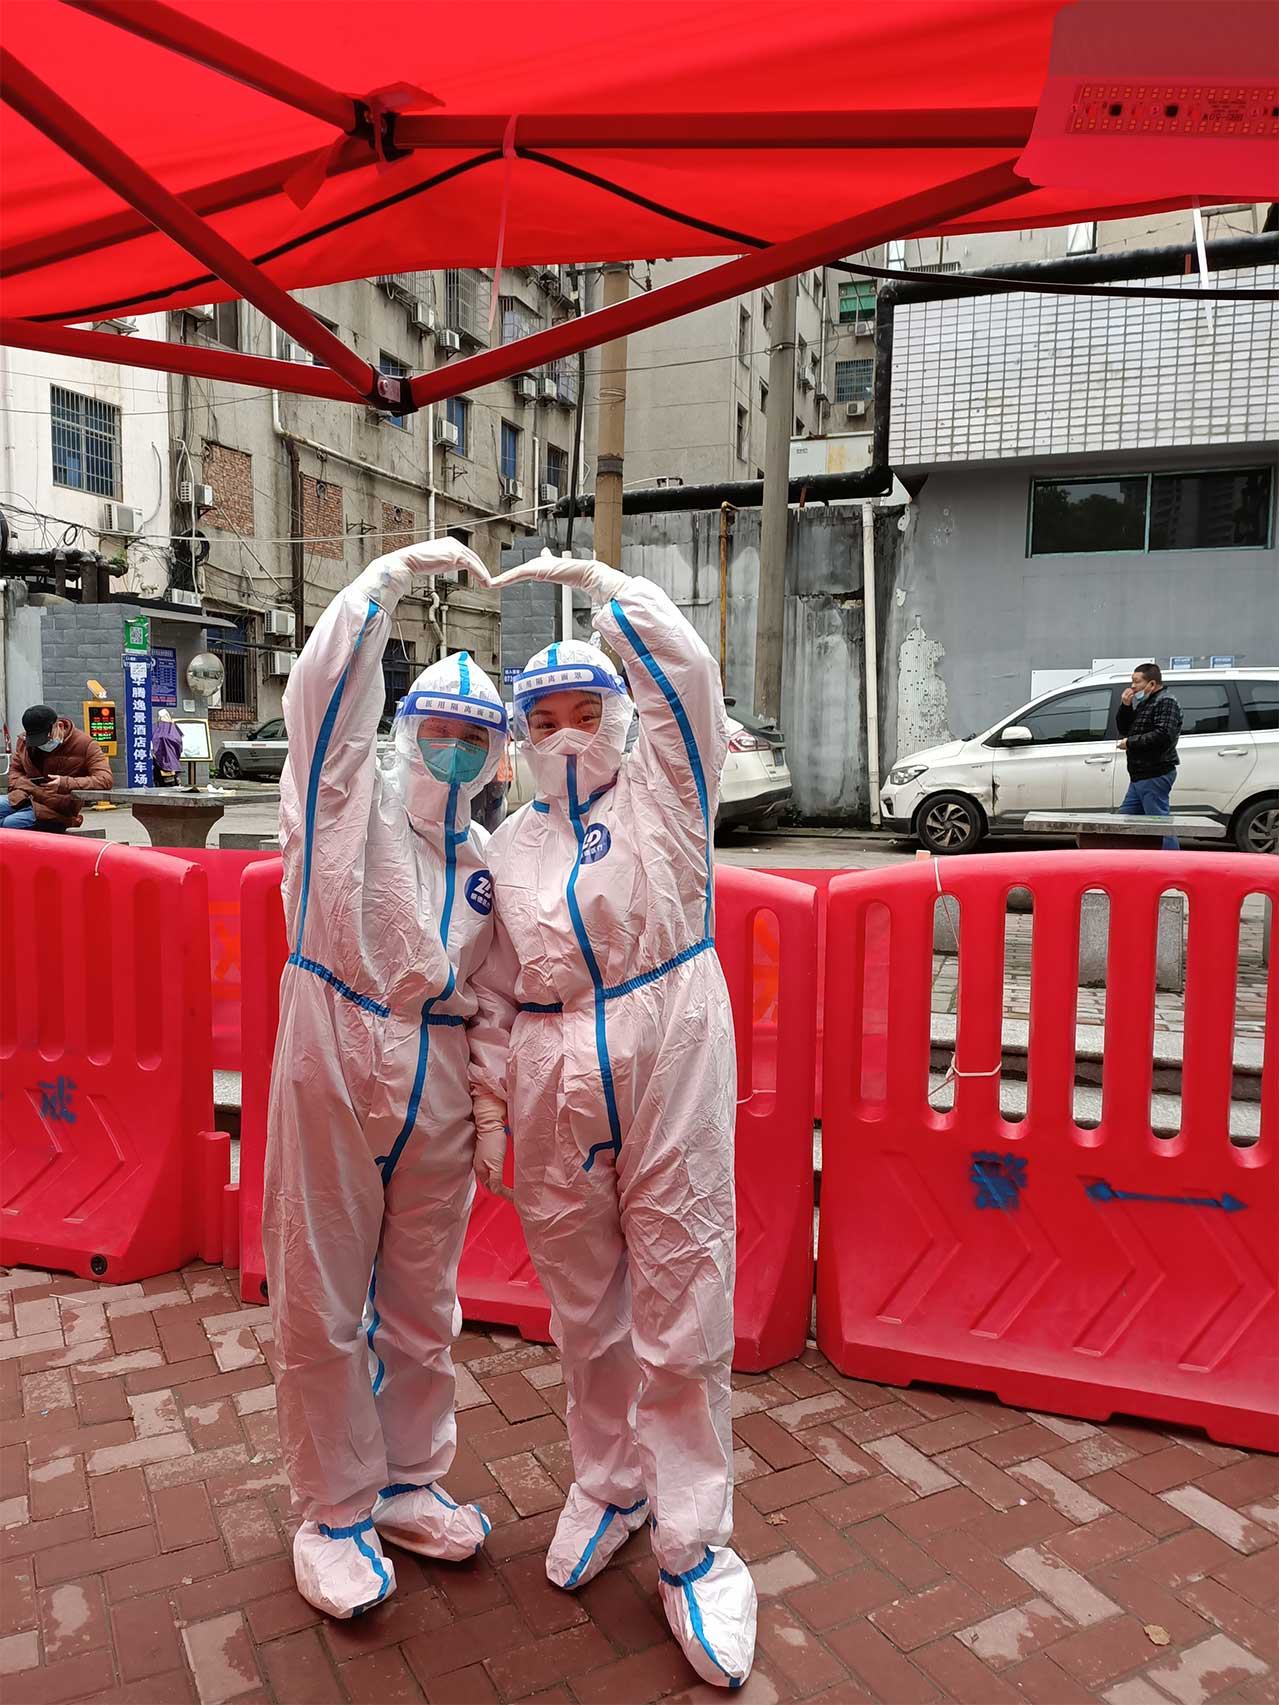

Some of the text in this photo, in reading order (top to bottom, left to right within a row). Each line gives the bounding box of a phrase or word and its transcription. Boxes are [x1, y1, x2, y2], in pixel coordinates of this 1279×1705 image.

[131, 677, 148, 785] 华腾逸景酒店停车场
[425, 699, 495, 720] 医用隔离面罩
